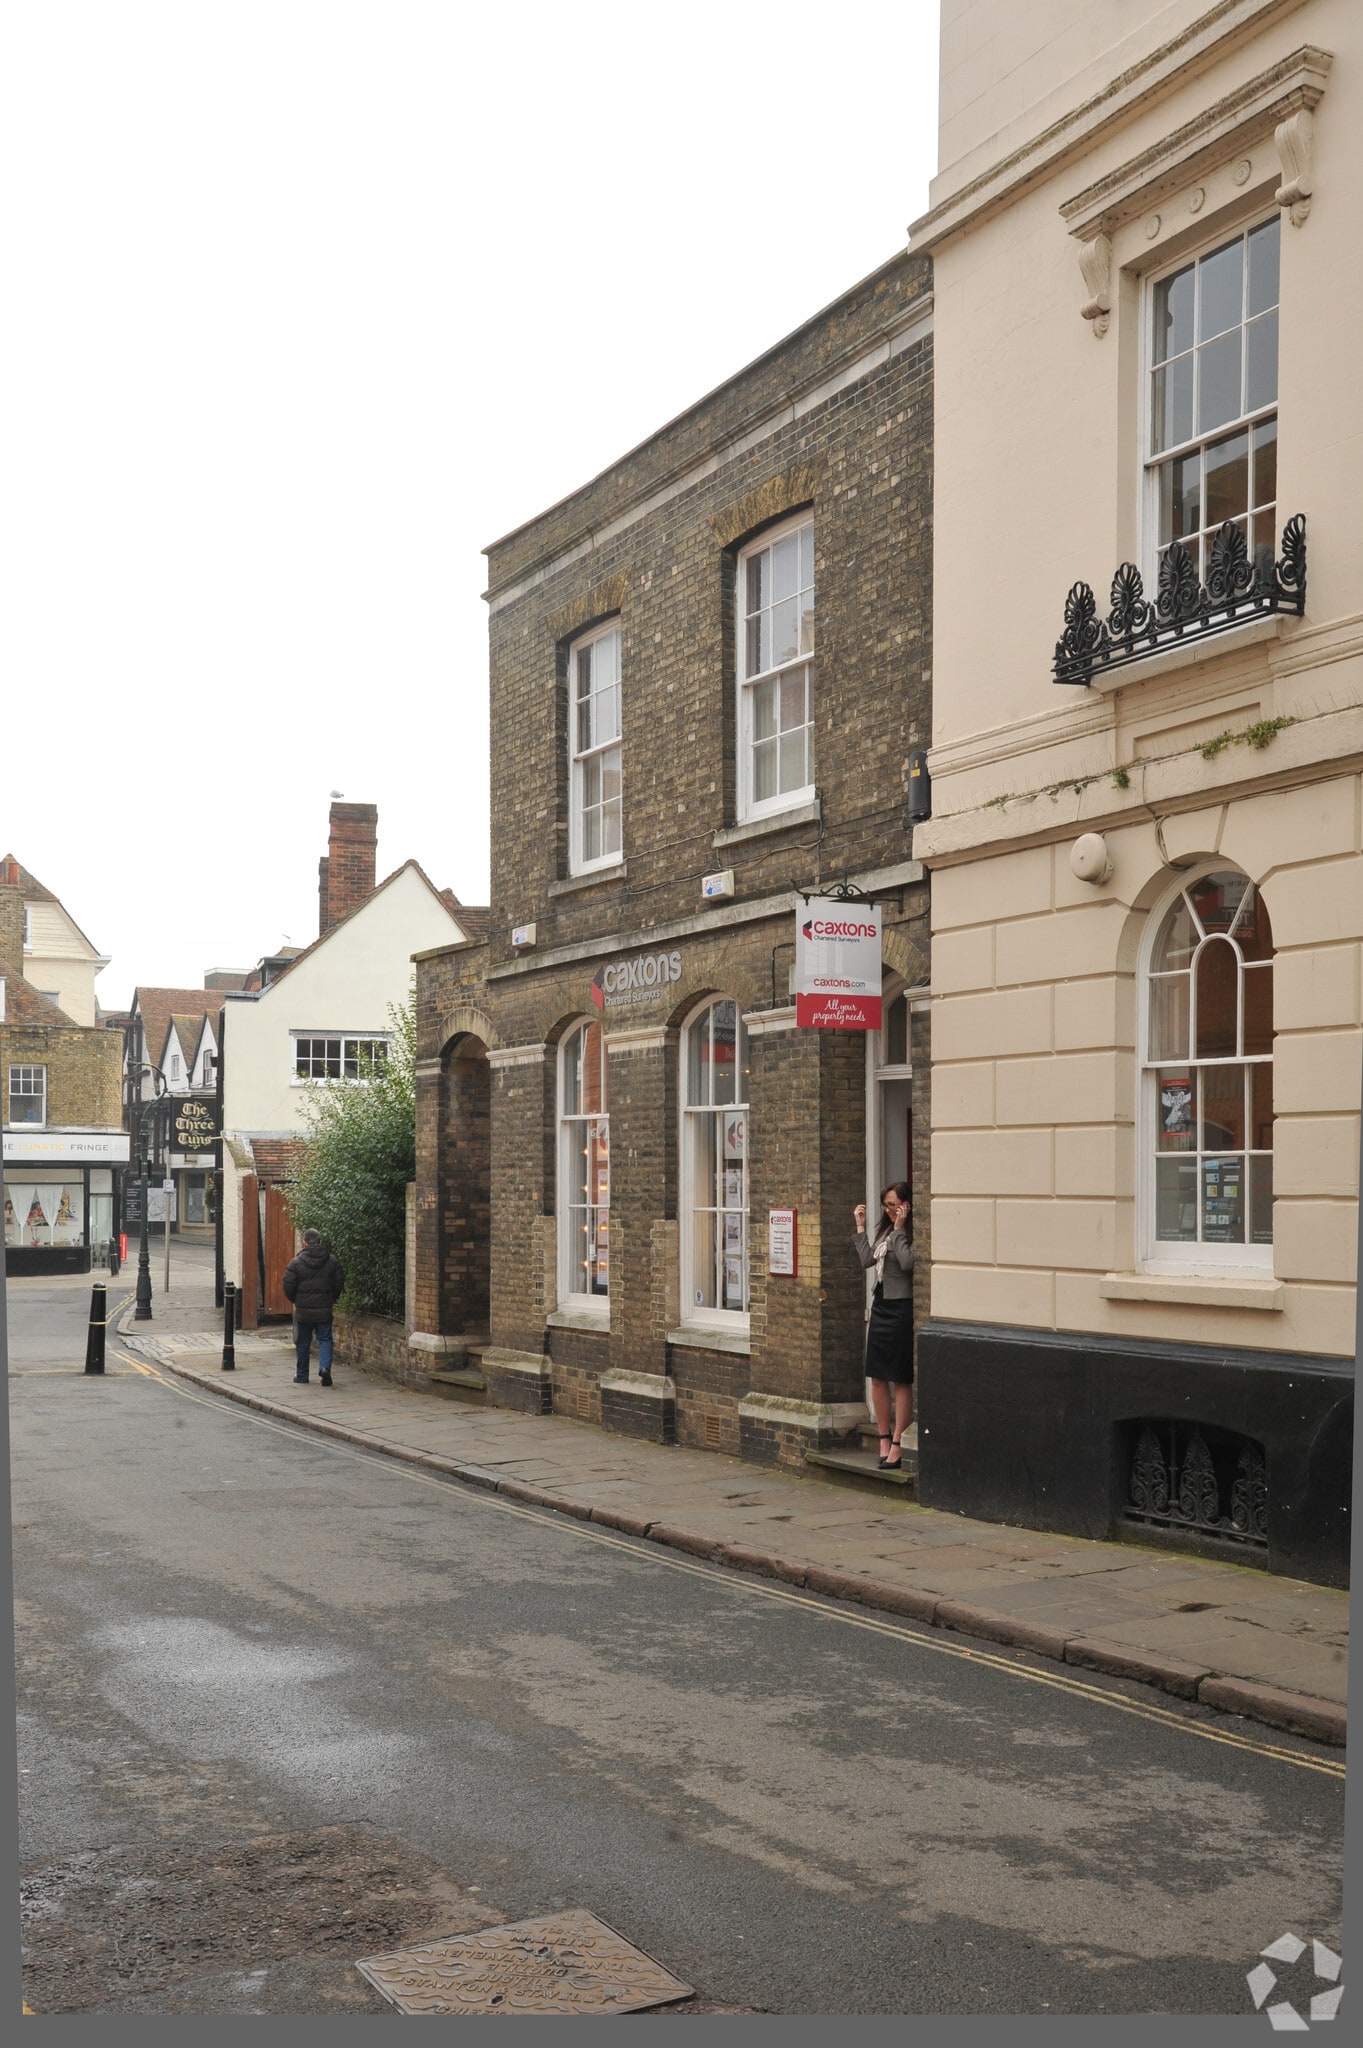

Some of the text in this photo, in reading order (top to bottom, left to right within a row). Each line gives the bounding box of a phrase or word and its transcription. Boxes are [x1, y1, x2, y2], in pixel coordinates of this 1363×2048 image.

[814, 921, 877, 938] caxtons
[814, 935, 861, 944] Chartered Surveyors
[604, 951, 682, 993] caxtons
[813, 978, 866, 988] caxtons.com
[604, 989, 661, 1007] Chartered Surveyors
[824, 999, 857, 1014] All your
[812, 1010, 866, 1025] property needs
[182, 1102, 208, 1117] The
[175, 1117, 215, 1132] Three
[178, 1132, 211, 1145] Tuns
[70, 1144, 109, 1152] FRINGE
[404, 1976, 493, 1994] STANTON
[475, 1973, 560, 1988] DUCTILE
